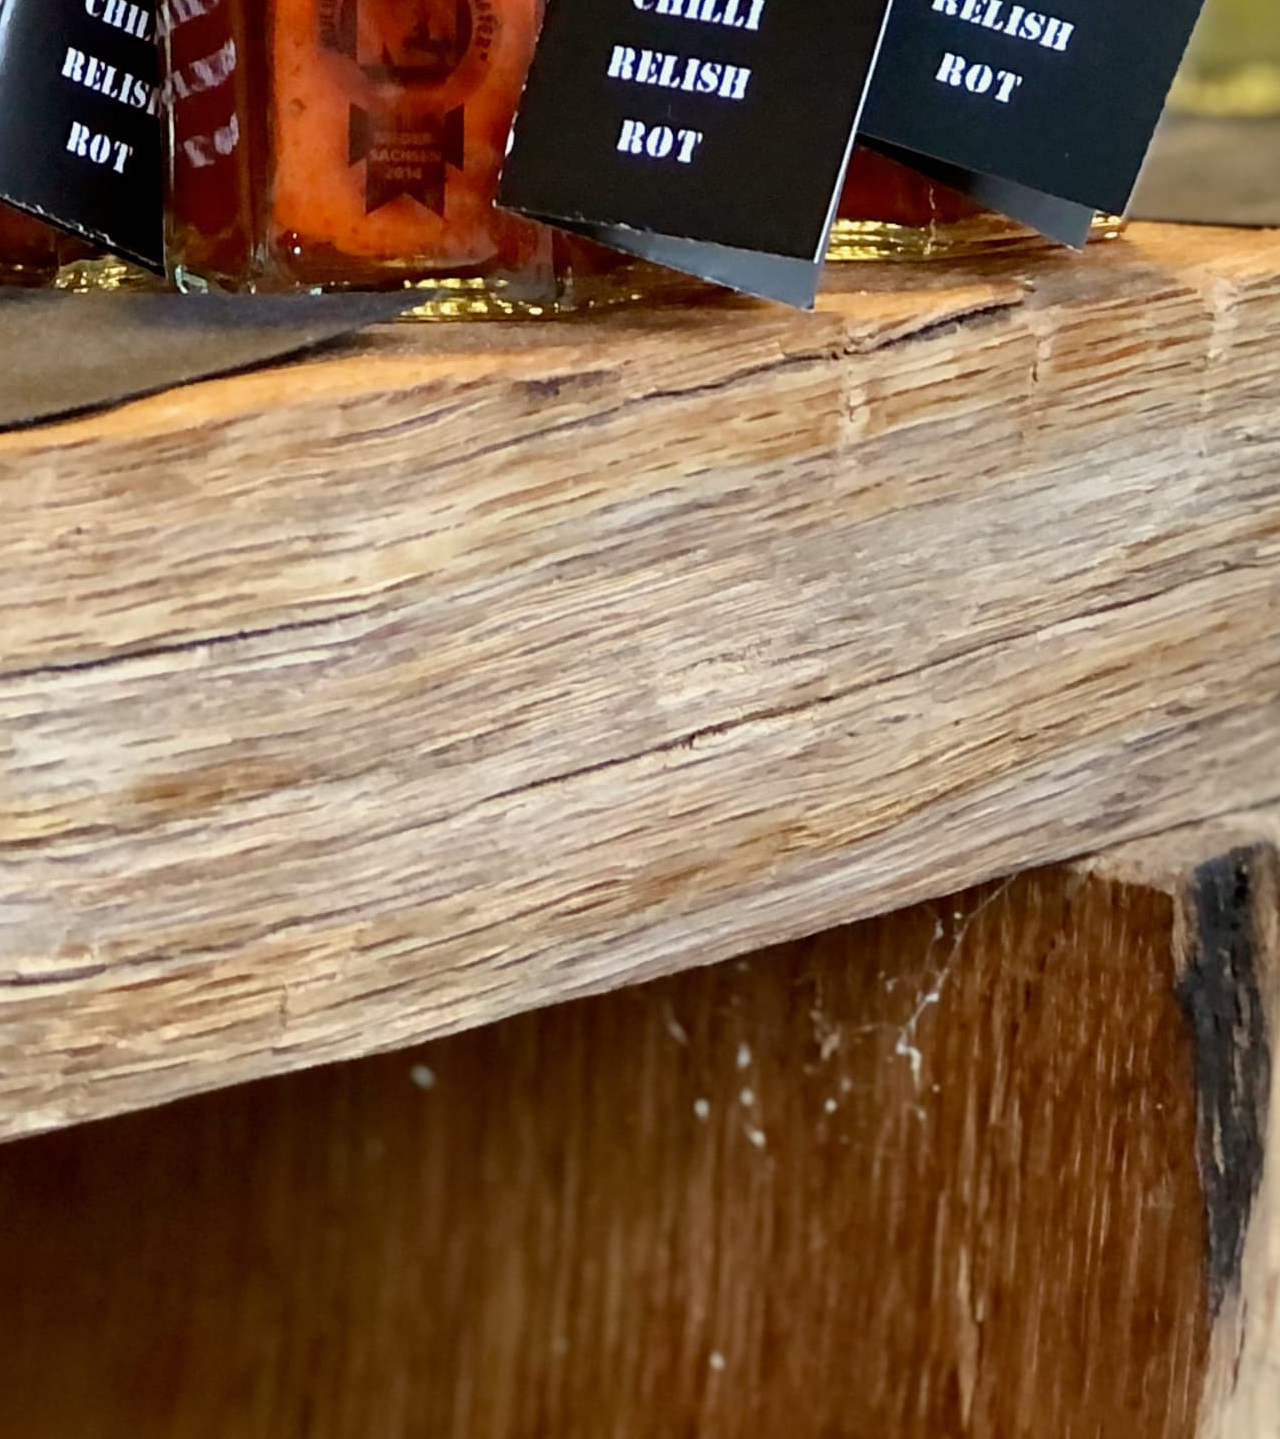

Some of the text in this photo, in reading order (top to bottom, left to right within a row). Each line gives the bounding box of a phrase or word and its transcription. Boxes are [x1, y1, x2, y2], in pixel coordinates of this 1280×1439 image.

[607, 45, 752, 100] RELISH
[935, 52, 1023, 103] ROT
[66, 121, 133, 174] ROT
[616, 119, 704, 163] ROT
